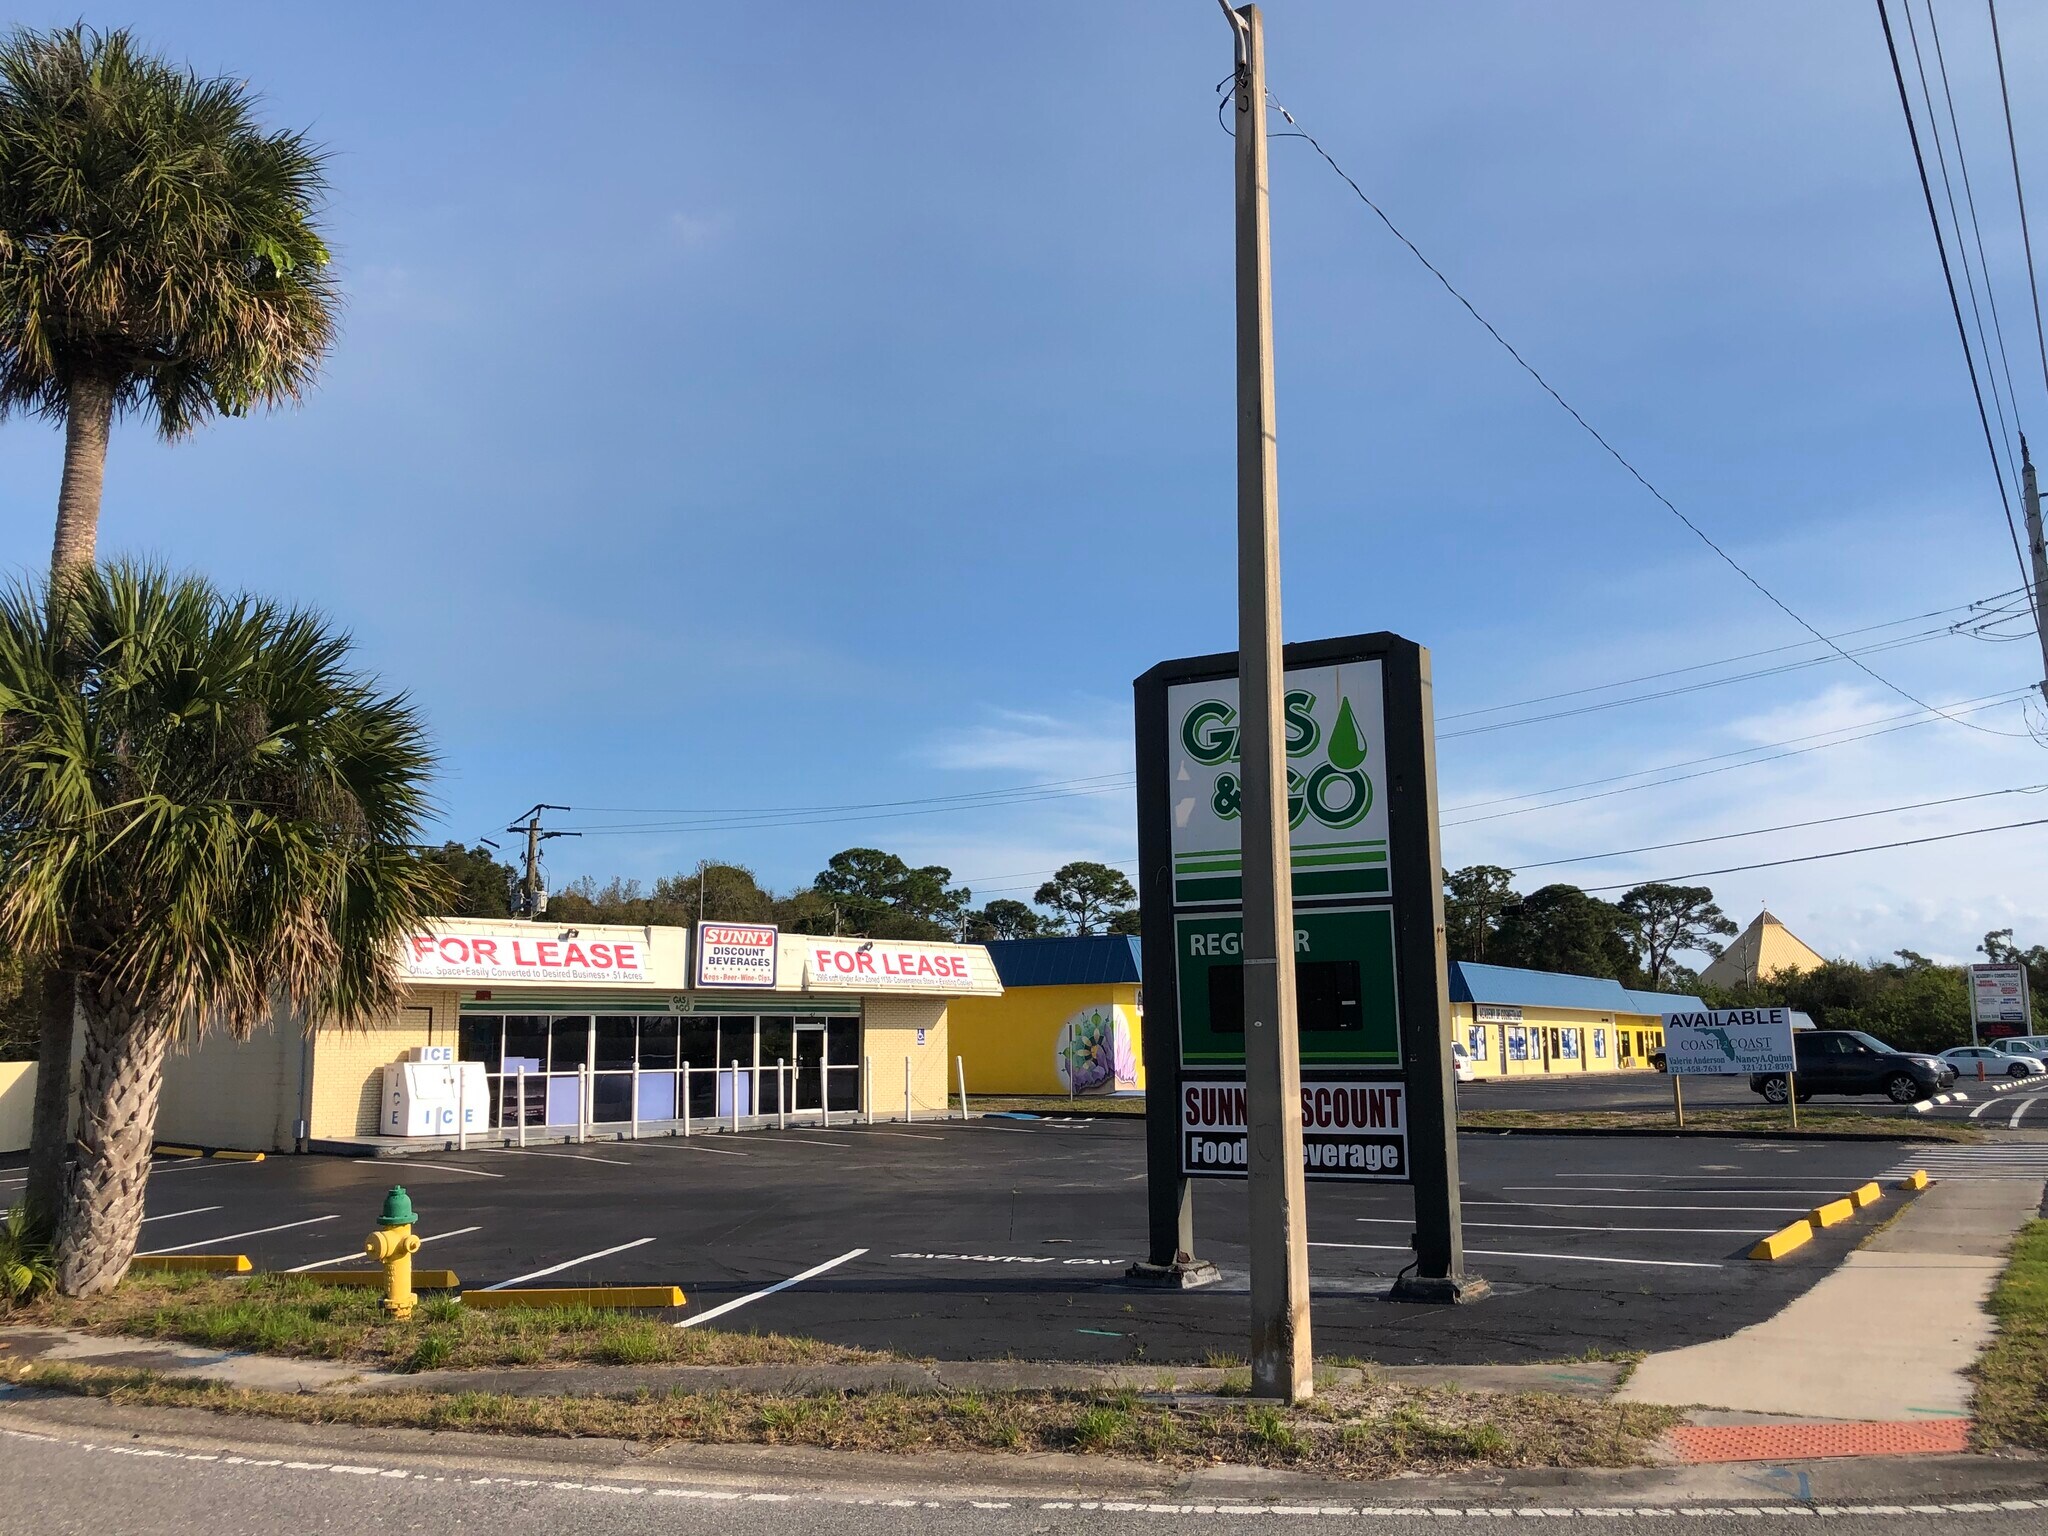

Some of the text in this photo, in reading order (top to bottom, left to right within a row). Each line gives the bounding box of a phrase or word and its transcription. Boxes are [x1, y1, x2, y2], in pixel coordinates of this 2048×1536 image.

[1180, 689, 1321, 766] GS
[706, 929, 771, 944] SUNNY
[1190, 929, 1311, 956] REGR
[413, 937, 638, 969] FOR LEASE
[714, 947, 765, 957] DISCOUNT
[709, 957, 770, 967] BEVERAGES
[816, 950, 968, 978] FOR LEASE
[436, 966, 461, 977] Space
[466, 967, 489, 978] Easily
[492, 968, 531, 978] Converted
[533, 969, 540, 977] to
[543, 969, 571, 979] Desired
[572, 970, 605, 979] Business
[623, 971, 643, 980] Acres
[704, 973, 719, 981] Kegs
[1669, 1010, 1782, 1028] AVAILABLE
[1681, 1039, 1720, 1050] COAST
[1729, 1037, 1771, 1049] COAST
[424, 1048, 451, 1060] ICE
[1693, 1056, 1725, 1064] Anderson
[1741, 1063, 1793, 1072] 321-212-8391
[1185, 1087, 1402, 1129] SUNN SCOUNT
[425, 1109, 473, 1124] ICE
[1191, 1137, 1399, 1171] Food everage
